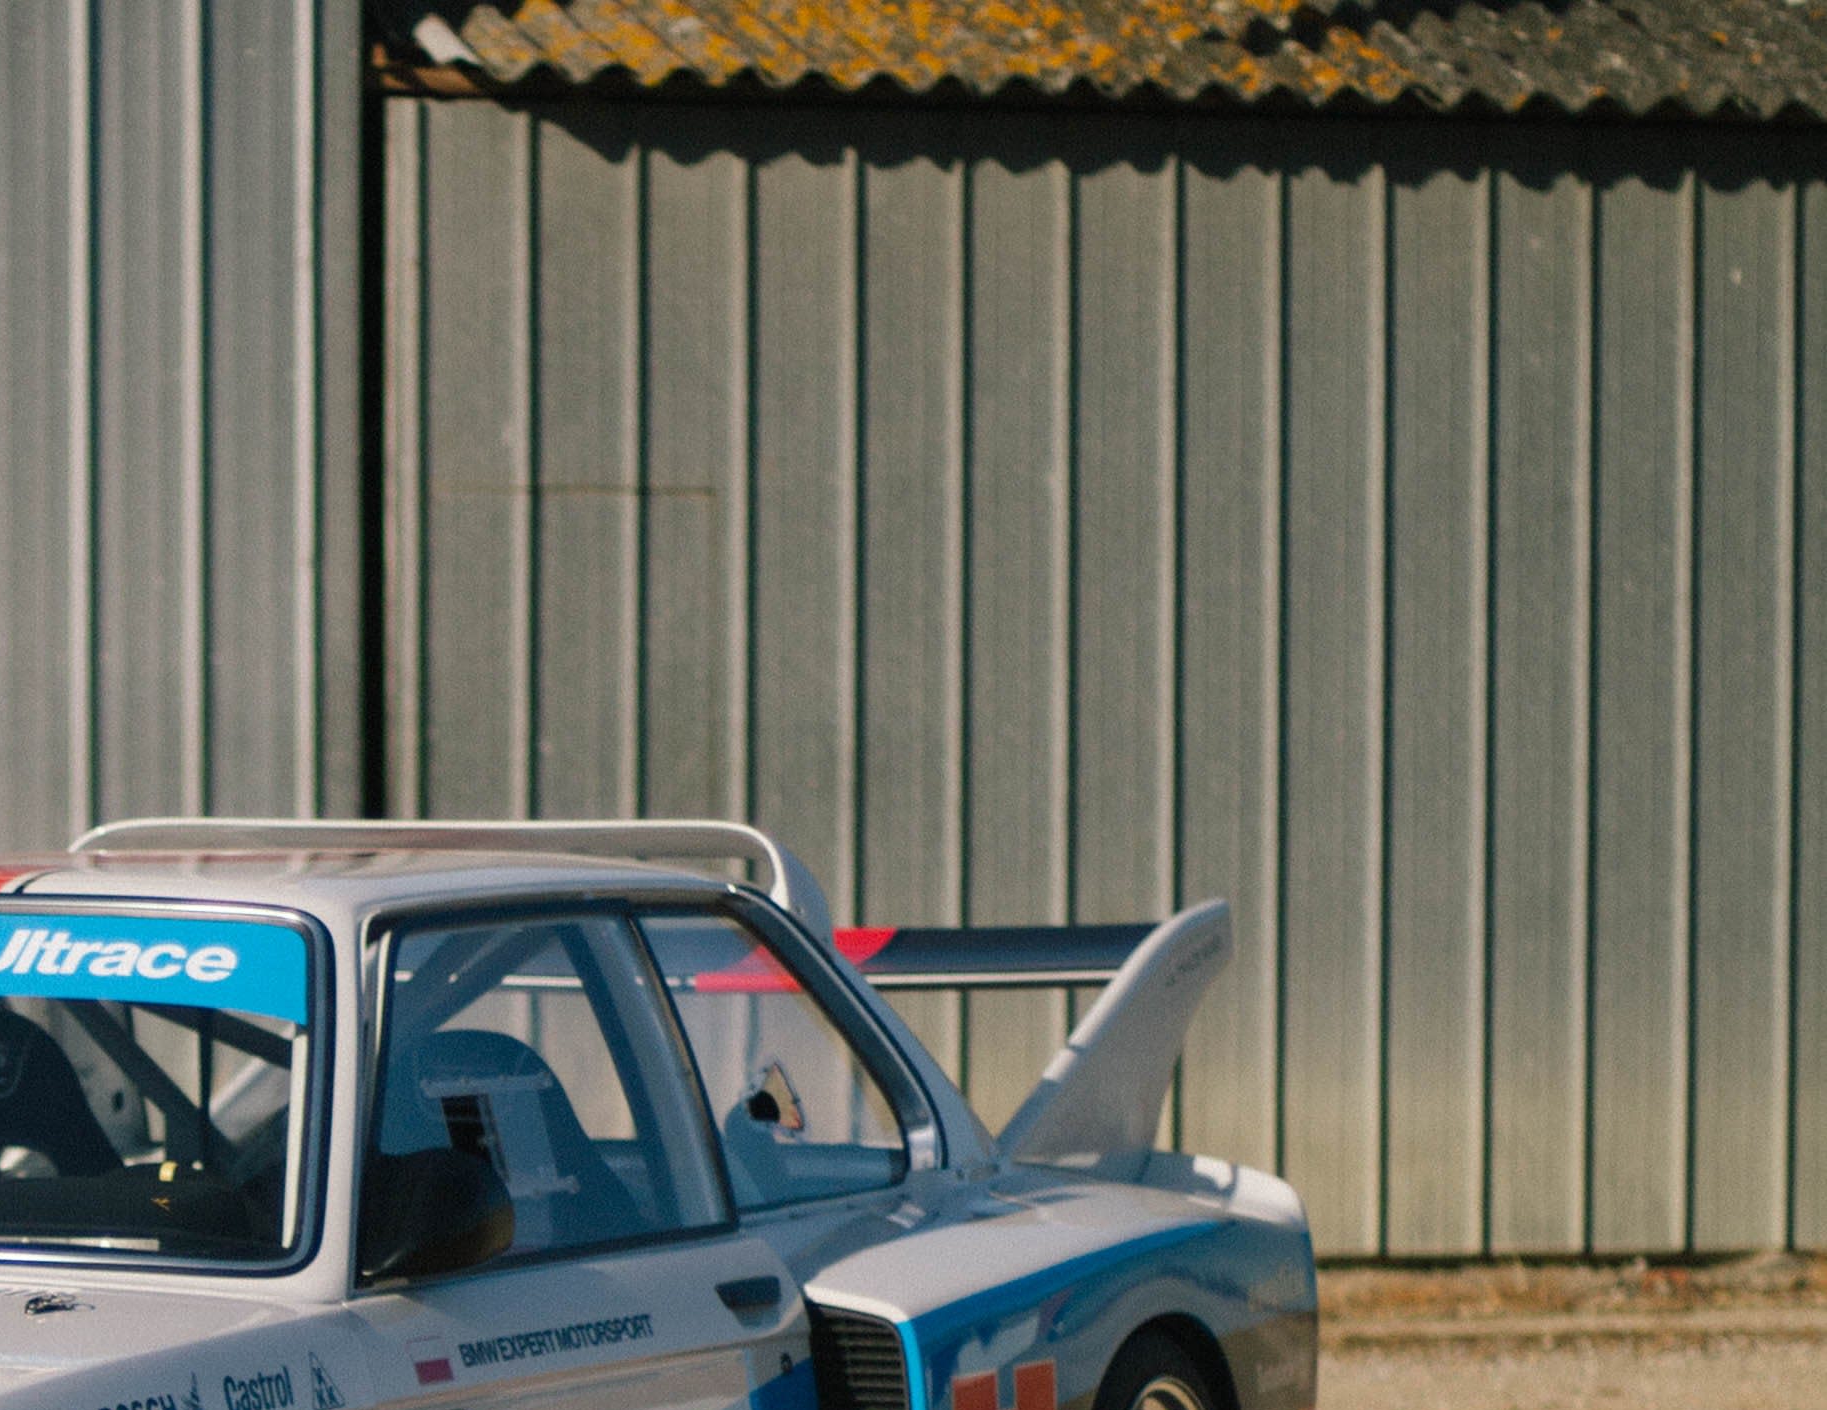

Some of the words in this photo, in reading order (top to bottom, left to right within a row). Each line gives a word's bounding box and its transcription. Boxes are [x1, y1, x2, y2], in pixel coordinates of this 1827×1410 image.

[458, 1338, 499, 1368] BMW
[499, 1329, 557, 1362] EXPERT
[556, 1313, 655, 1351] MOTORSPORT
